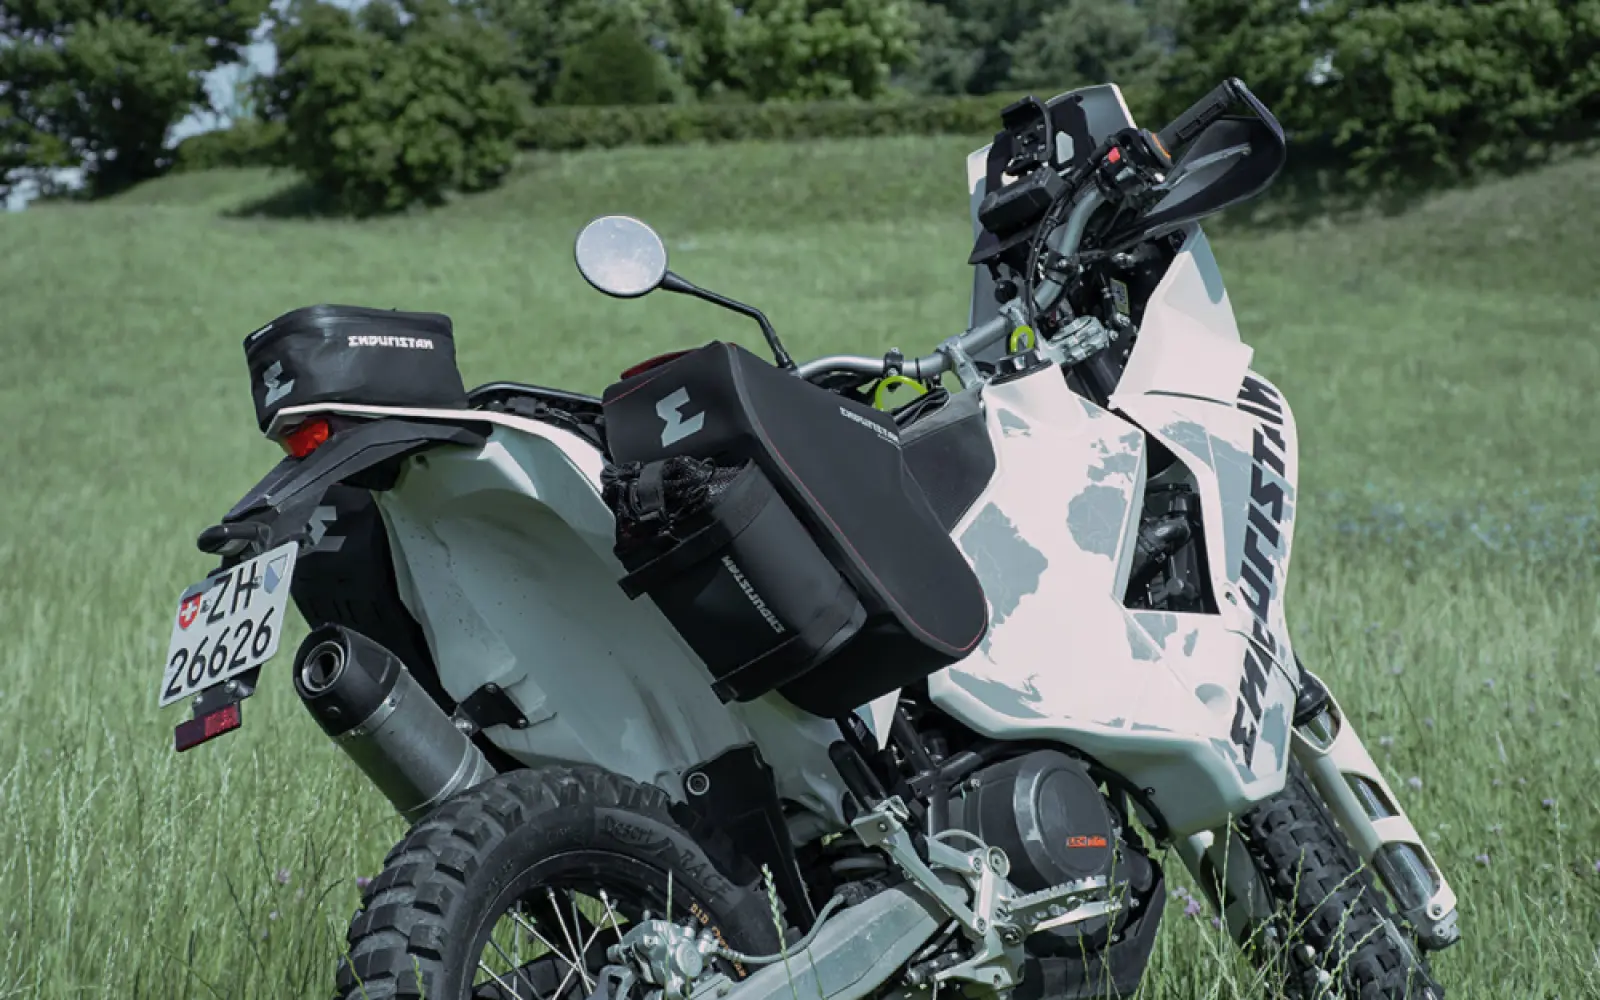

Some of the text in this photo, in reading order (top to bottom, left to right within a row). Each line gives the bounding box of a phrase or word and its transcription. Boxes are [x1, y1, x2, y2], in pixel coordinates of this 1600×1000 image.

[347, 335, 434, 350] ENDURISTAN
[206, 561, 260, 626] ZH
[721, 555, 786, 634] ENDURISTAN
[162, 606, 275, 701] 26626
